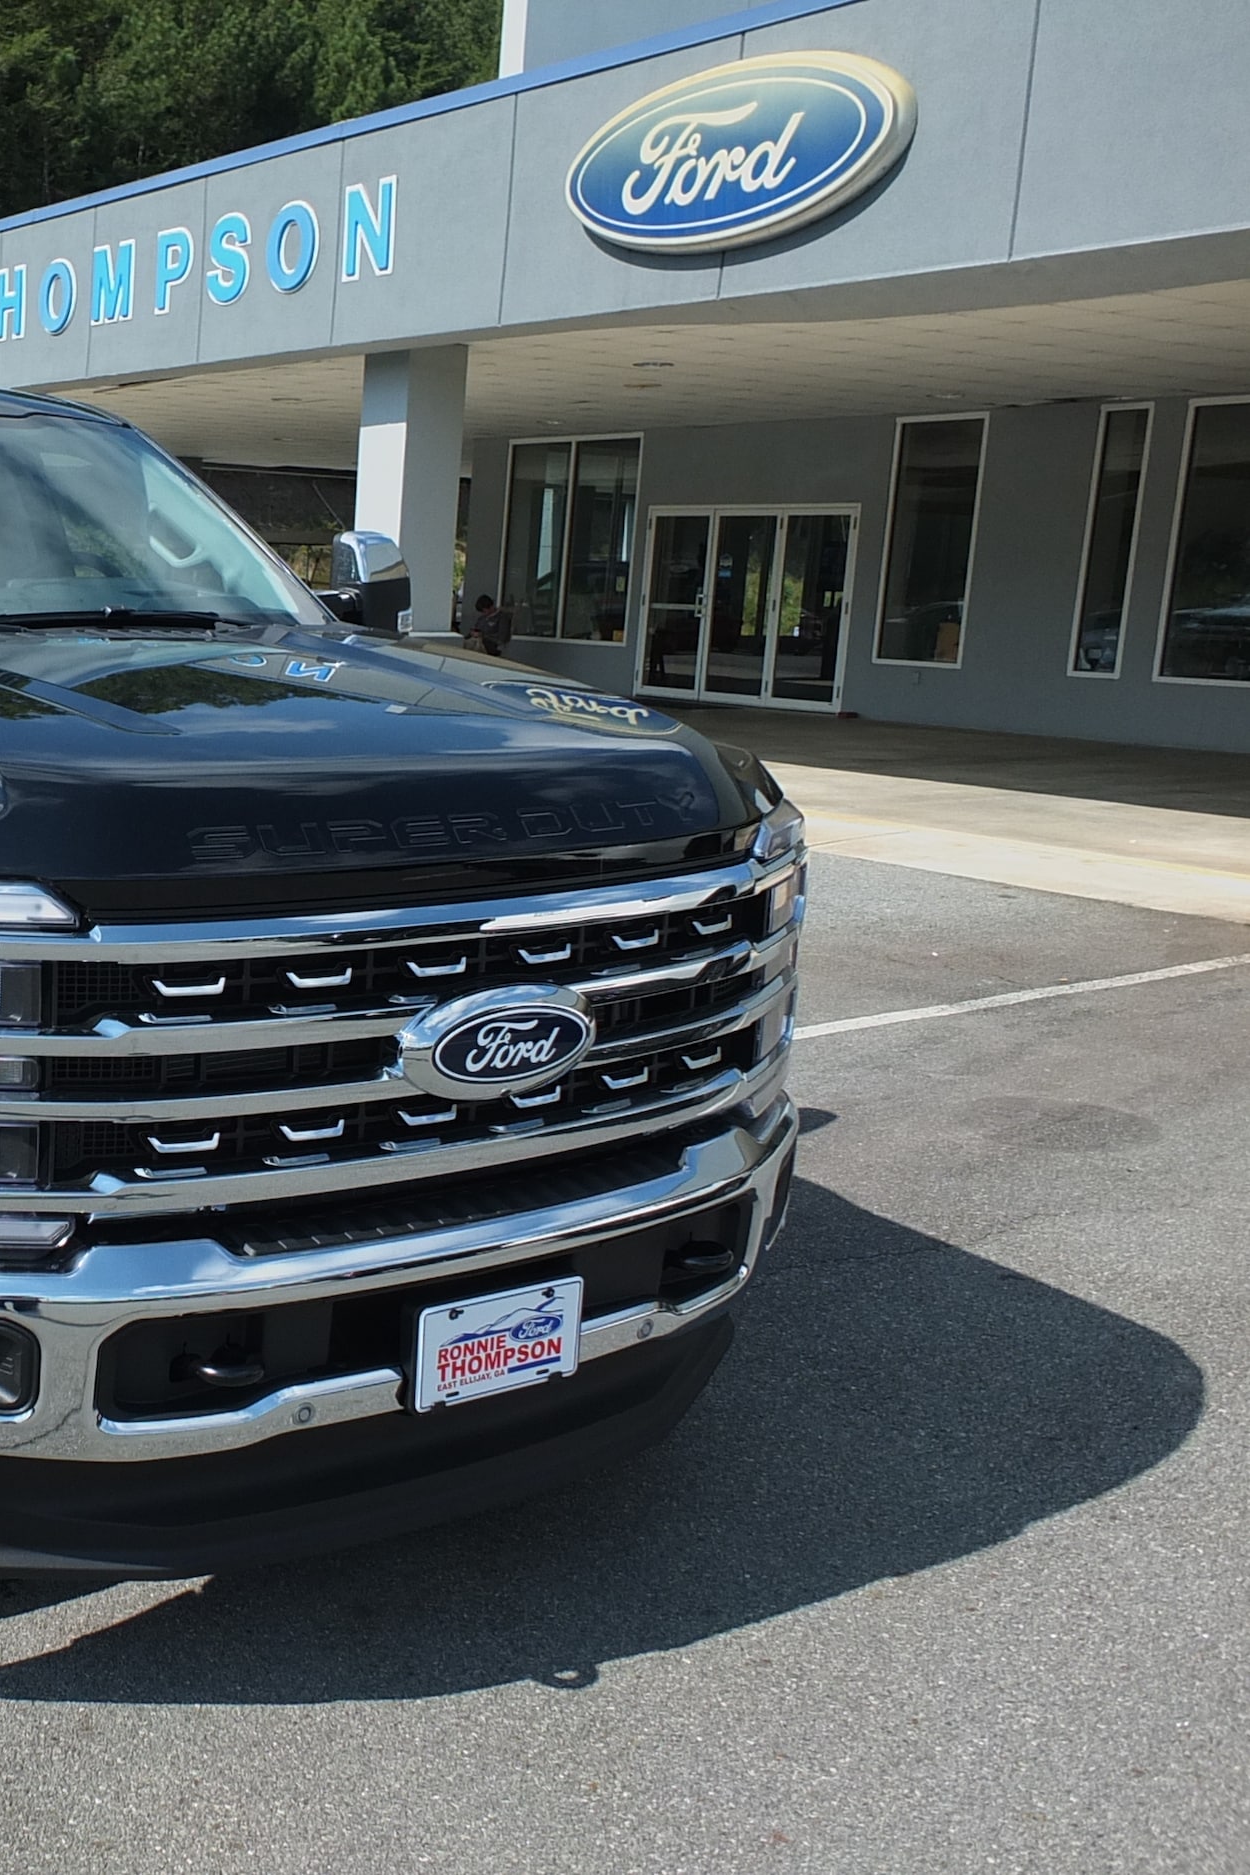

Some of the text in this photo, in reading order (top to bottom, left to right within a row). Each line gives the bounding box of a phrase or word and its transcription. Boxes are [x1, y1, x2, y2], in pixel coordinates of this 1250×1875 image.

[621, 101, 805, 215] Ford
[186, 811, 508, 861] SUPER
[465, 1019, 560, 1073] Ford
[437, 1334, 507, 1364] RONNIE
[518, 1319, 552, 1338] Ford
[437, 1336, 562, 1382] THOMPSON
[437, 1369, 505, 1392] EAST ELLIJAY, GA
